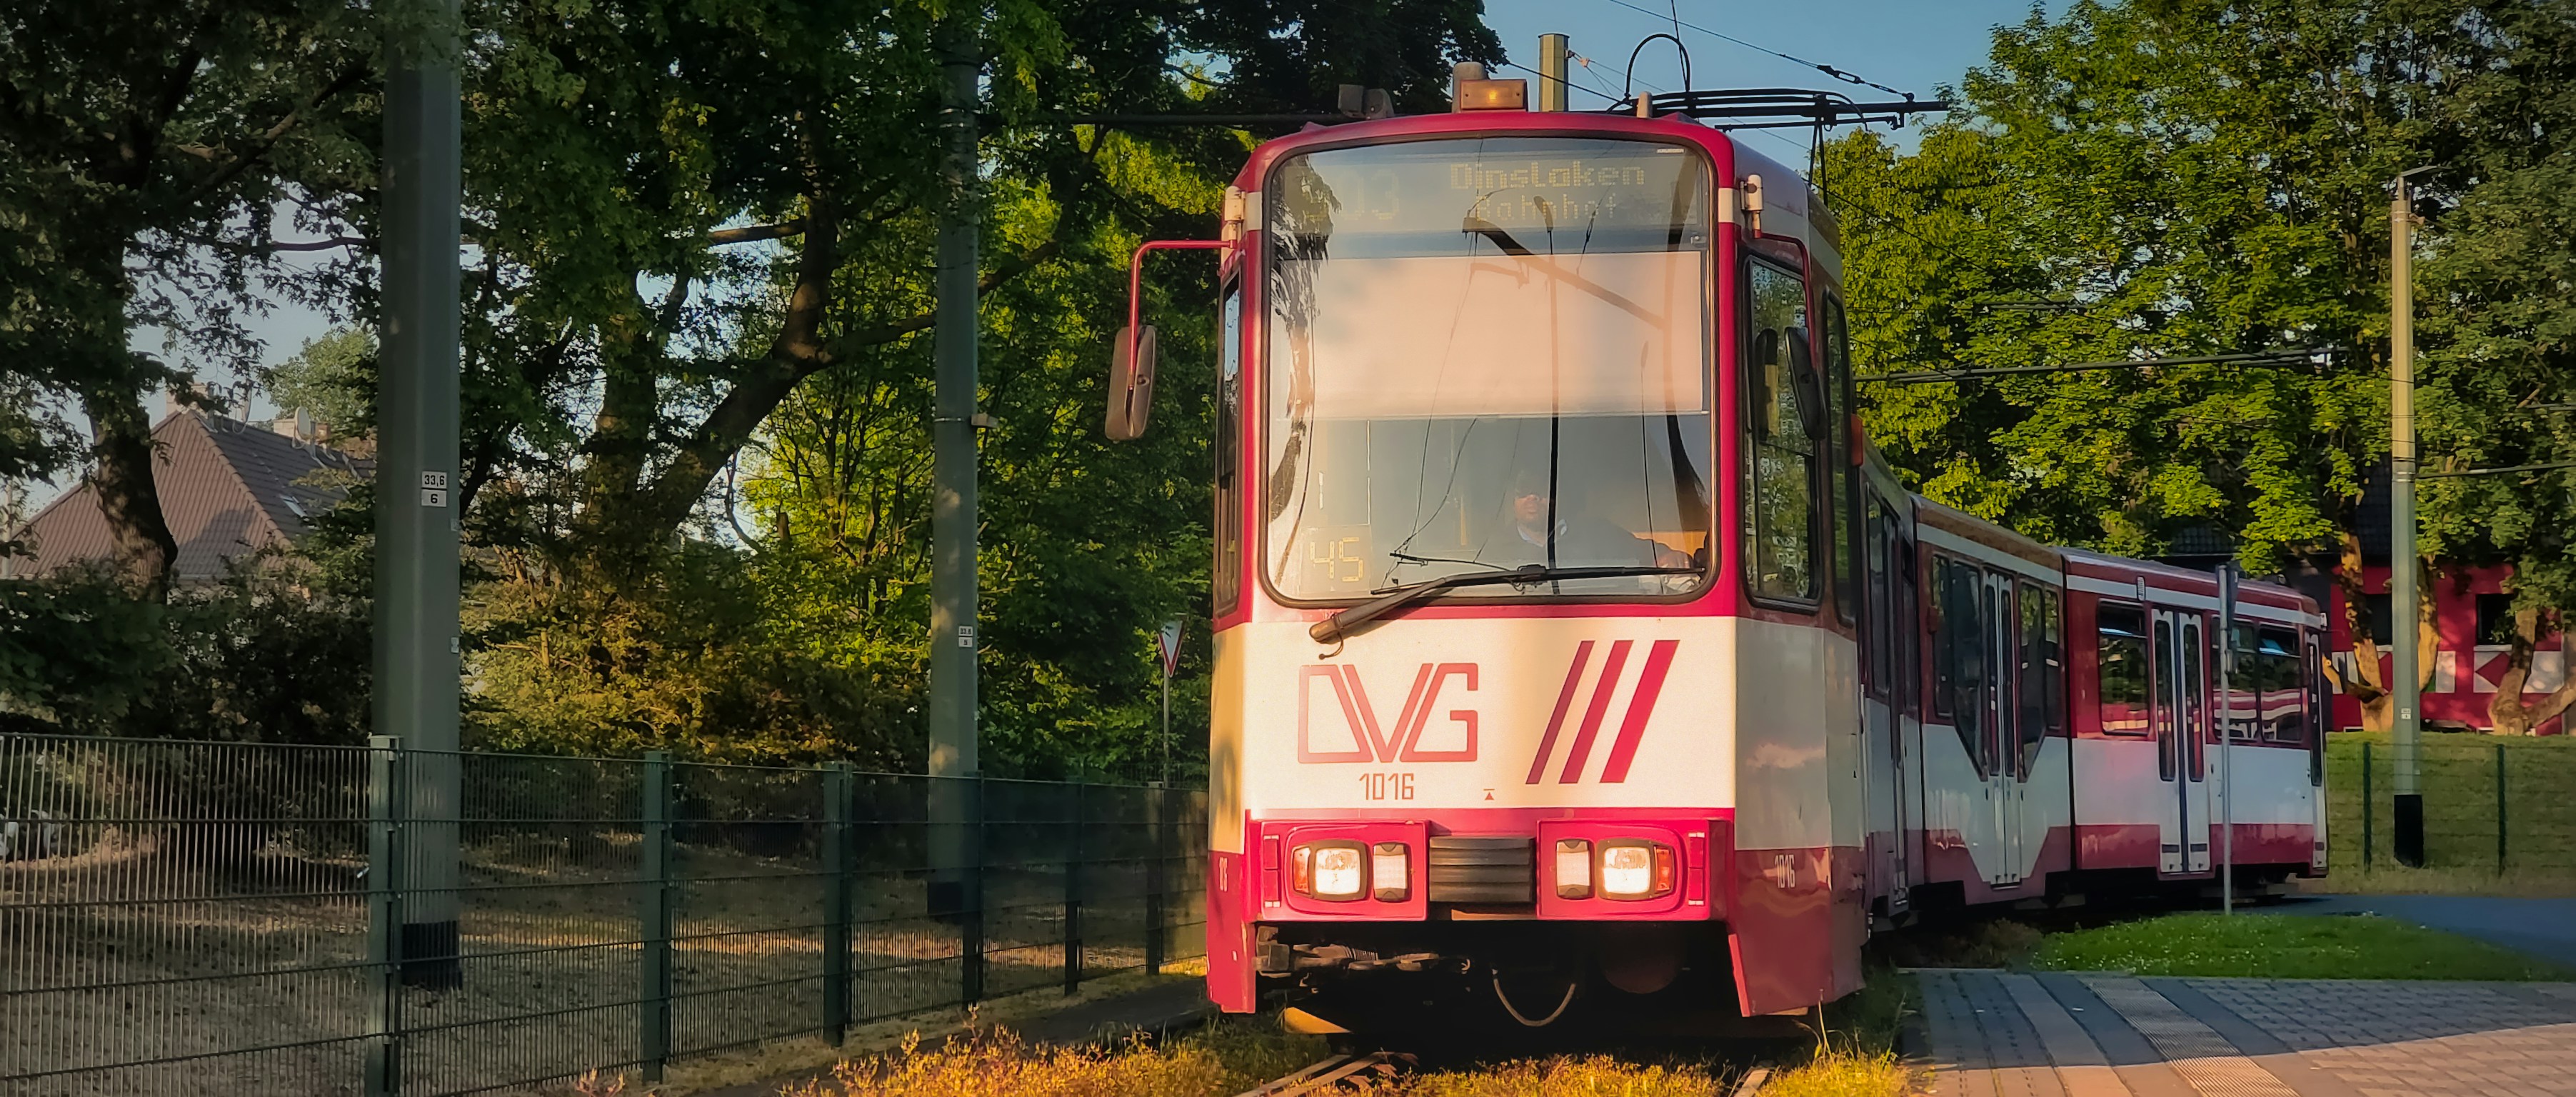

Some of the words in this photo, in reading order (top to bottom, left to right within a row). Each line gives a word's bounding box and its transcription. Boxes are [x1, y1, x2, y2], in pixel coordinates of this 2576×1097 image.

[1450, 160, 1645, 189] Dinslaken
[1476, 192, 1617, 221] Bahnhof
[424, 474, 445, 487] 33,6
[431, 494, 438, 504] 6
[1310, 536, 1363, 582] 45
[1298, 663, 1478, 763] DVG
[1358, 773, 1415, 801] 1016
[1774, 854, 1796, 889] 1016
